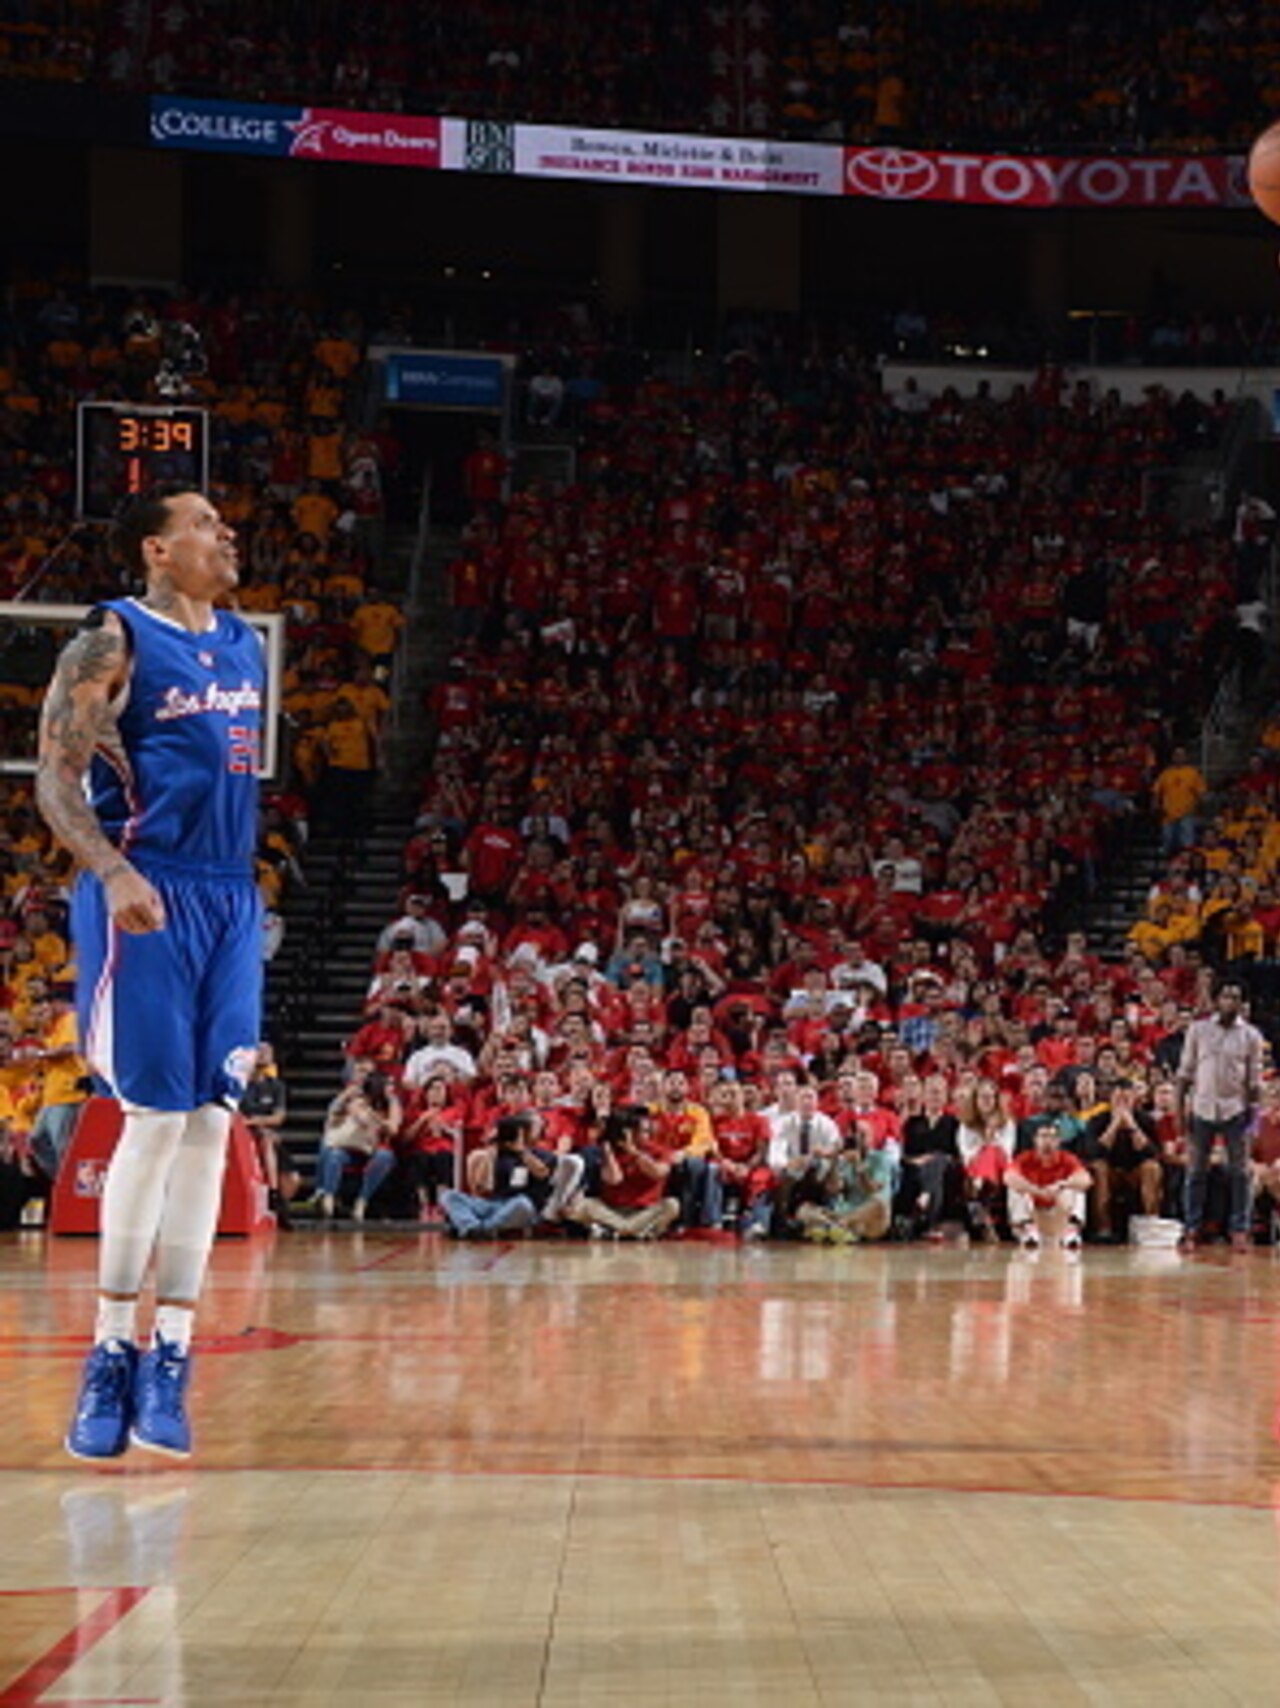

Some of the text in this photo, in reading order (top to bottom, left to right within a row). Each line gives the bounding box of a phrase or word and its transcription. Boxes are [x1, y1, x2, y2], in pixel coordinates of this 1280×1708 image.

[159, 107, 278, 144] COLLEGE
[331, 124, 382, 148] Open
[938, 156, 1221, 204] TOYOTA
[118, 417, 193, 452] 3:39
